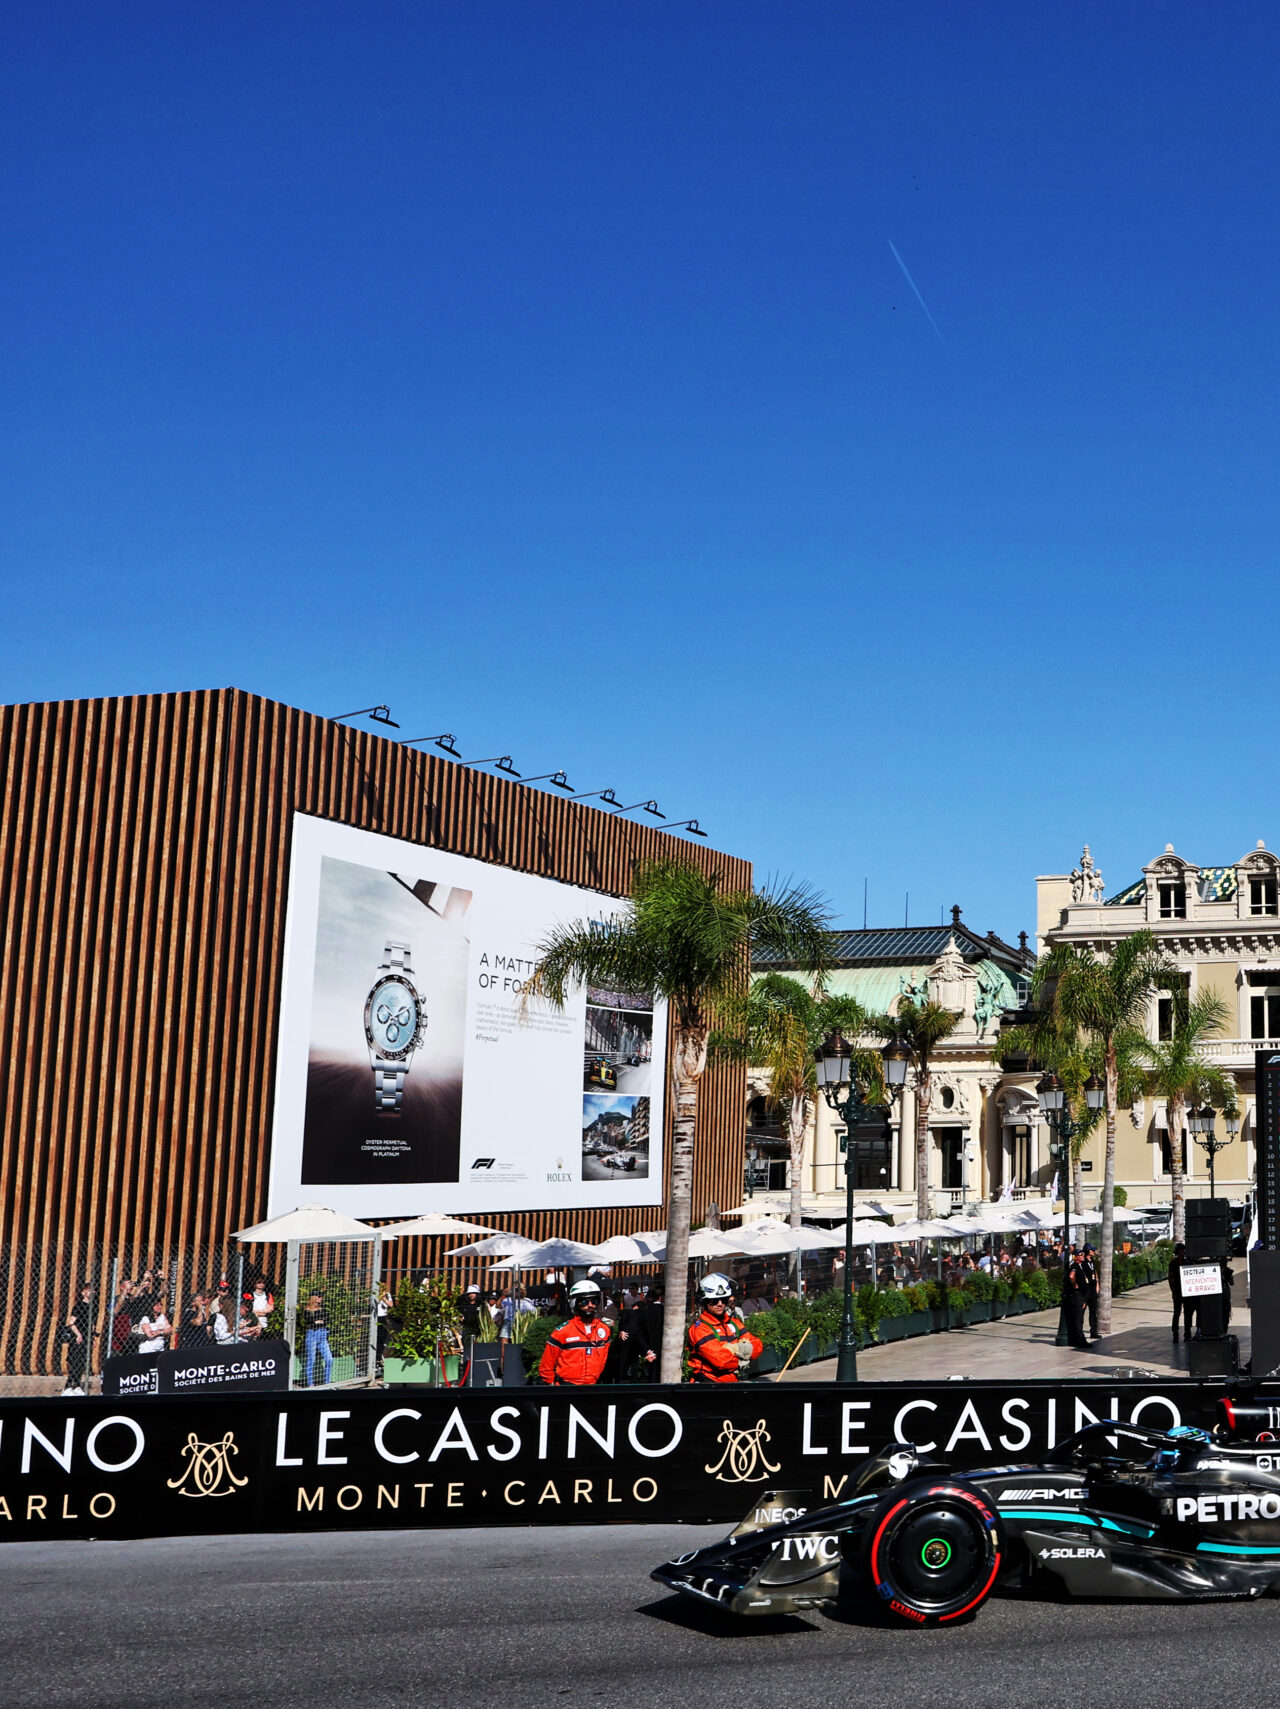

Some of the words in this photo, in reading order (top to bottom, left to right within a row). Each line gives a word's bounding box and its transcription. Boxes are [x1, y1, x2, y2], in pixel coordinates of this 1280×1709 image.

[479, 952, 490, 967] A
[478, 973, 499, 988] OF
[547, 1173, 572, 1182] ROLEX
[174, 1376, 206, 1387] SOCIÉTÉ
[208, 1375, 223, 1383] DES
[225, 1373, 247, 1382] BAINS
[119, 1384, 149, 1394] SOCIÉTÉ
[276, 1410, 351, 1466] LE
[374, 1403, 683, 1464] CASINO
[802, 1401, 871, 1455] LE
[1027, 1488, 1090, 1499] AMG
[780, 1536, 839, 1561] IWC
[1050, 1548, 1106, 1558] SOLERA
